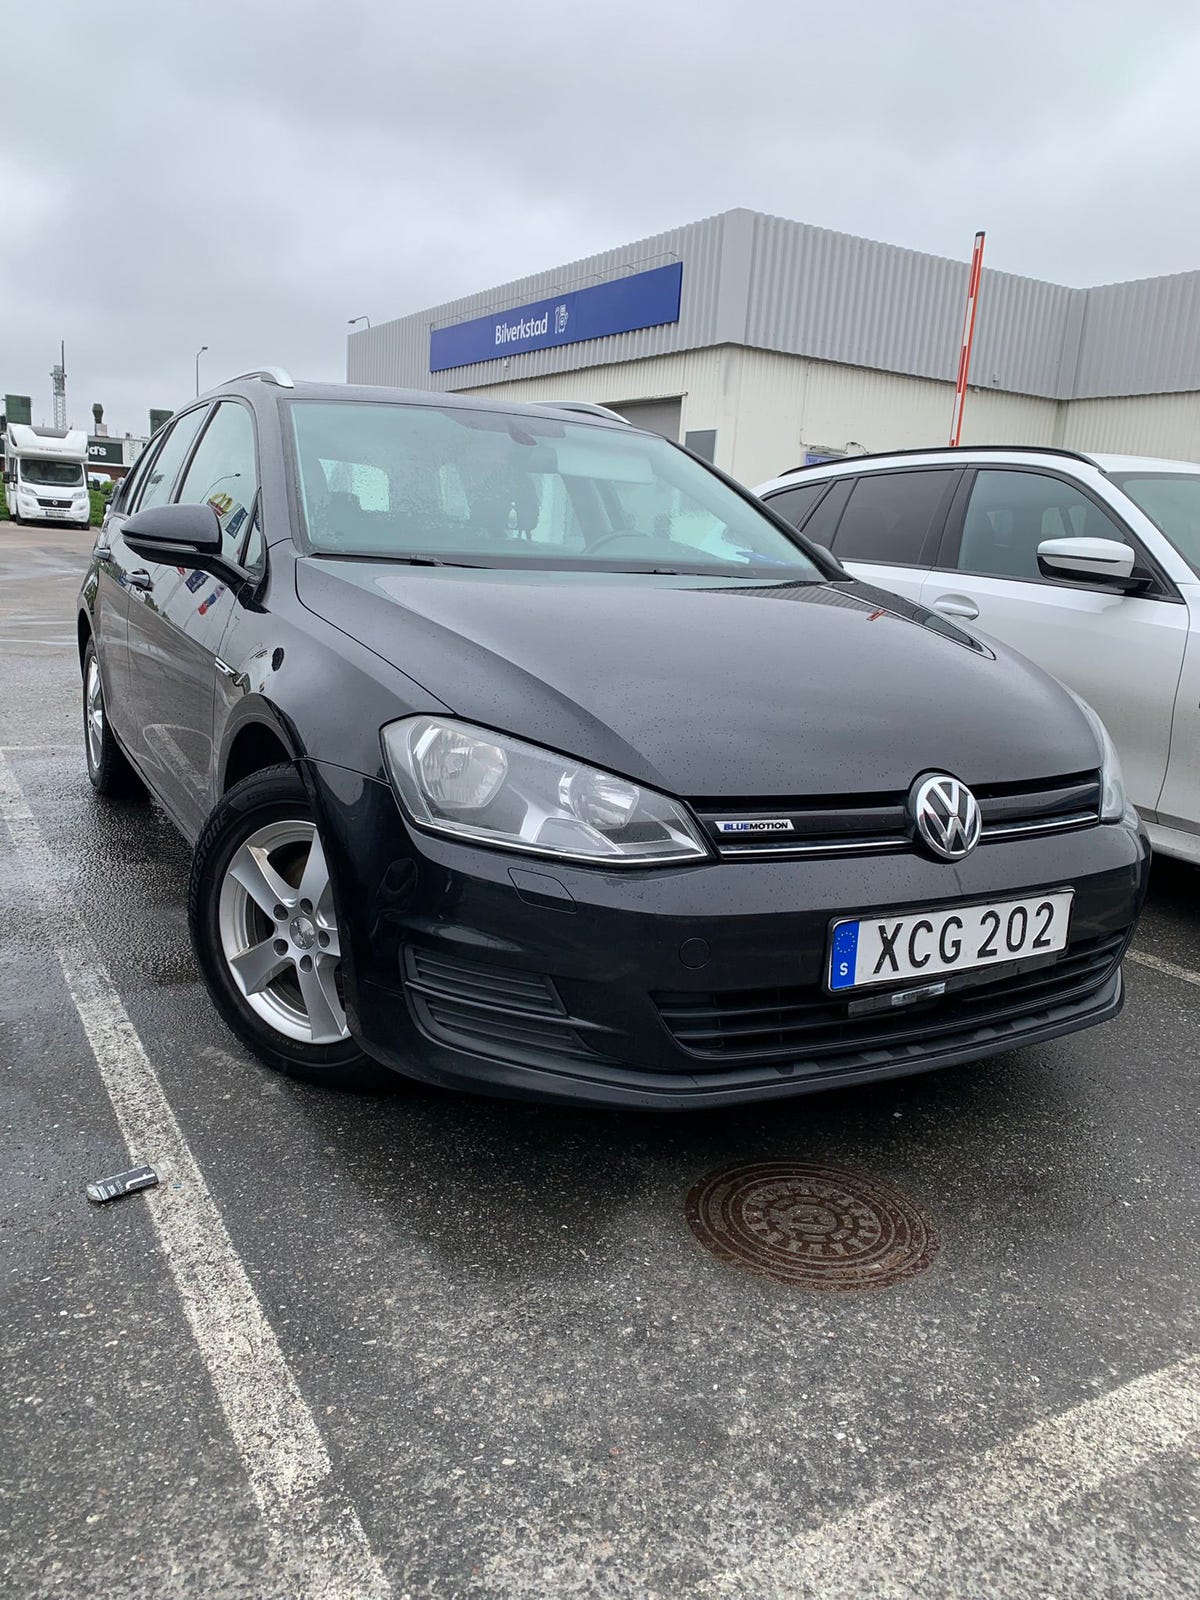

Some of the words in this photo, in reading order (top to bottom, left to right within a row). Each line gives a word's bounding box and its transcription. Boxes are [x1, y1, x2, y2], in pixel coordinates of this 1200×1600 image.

[494, 311, 549, 345] Bilverkstad
[723, 822, 789, 832] BLUEMOTION
[872, 915, 964, 976] XCG
[976, 901, 1056, 960] 202
[839, 962, 849, 977] S
